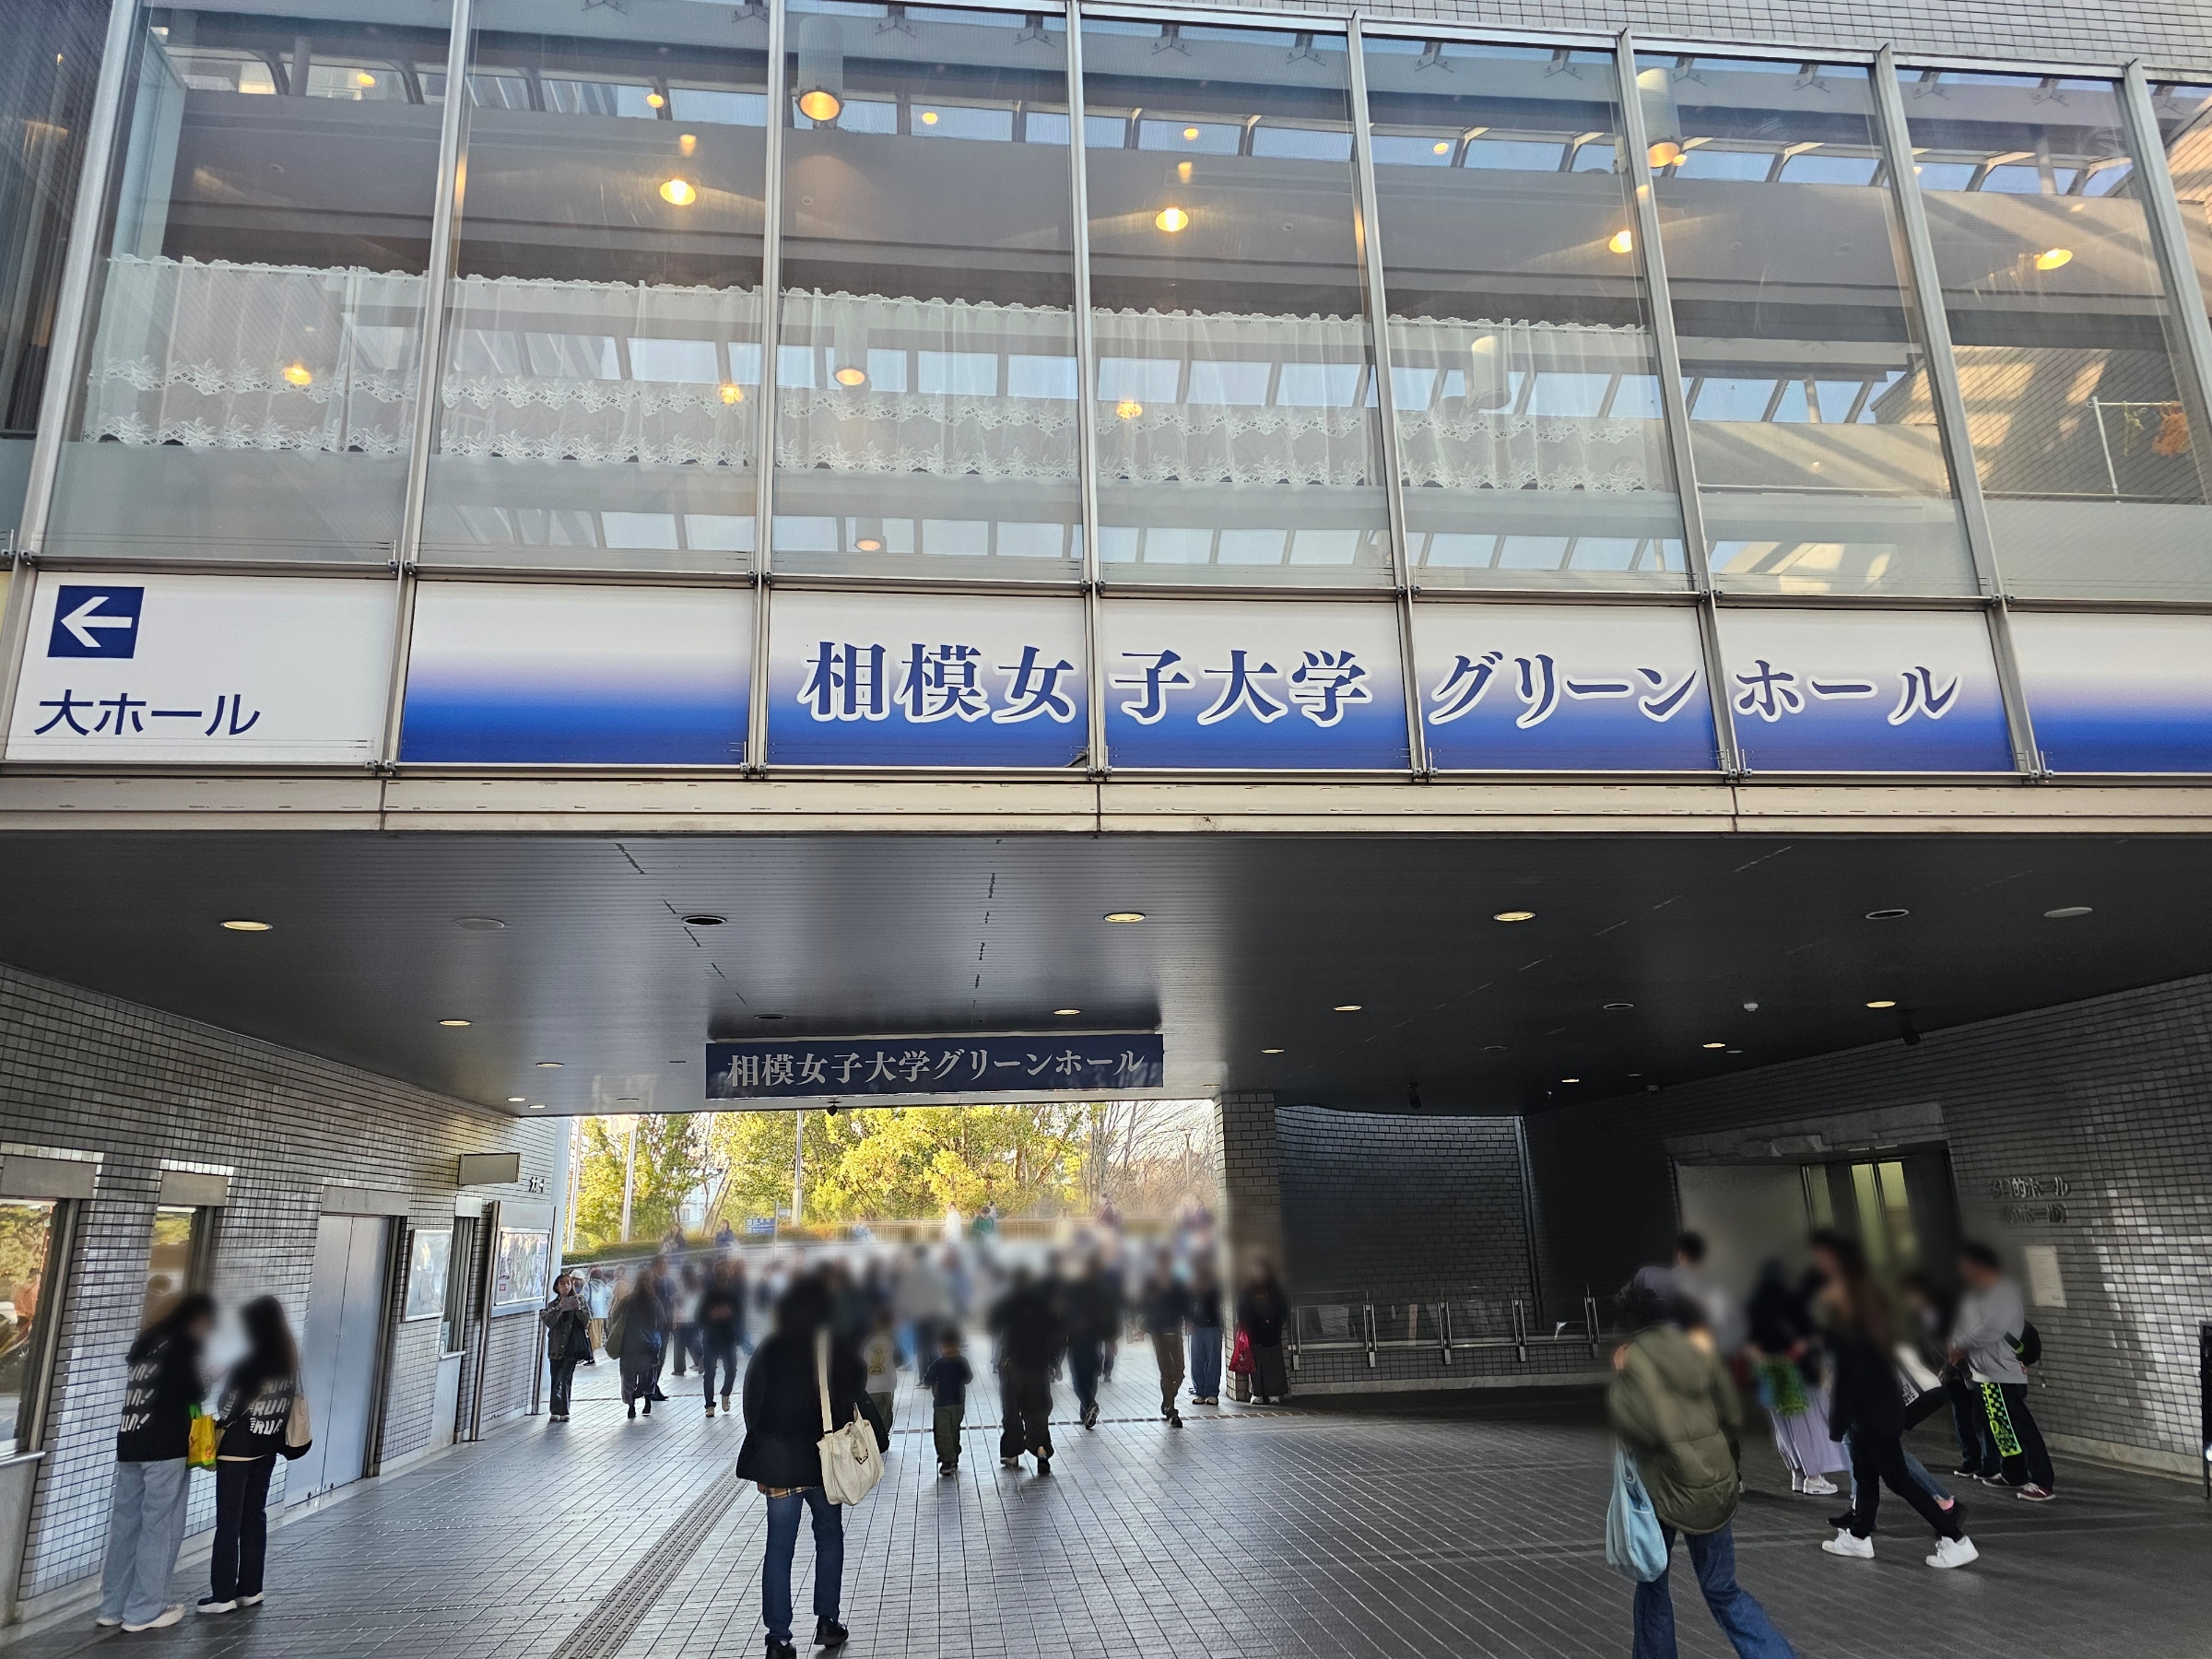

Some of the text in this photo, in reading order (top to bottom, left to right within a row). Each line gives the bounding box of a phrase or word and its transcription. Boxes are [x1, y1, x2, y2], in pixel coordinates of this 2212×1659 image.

[33, 688, 262, 737] 大ホール
[725, 1047, 1147, 1088] 相模女子大学グリーンホール
